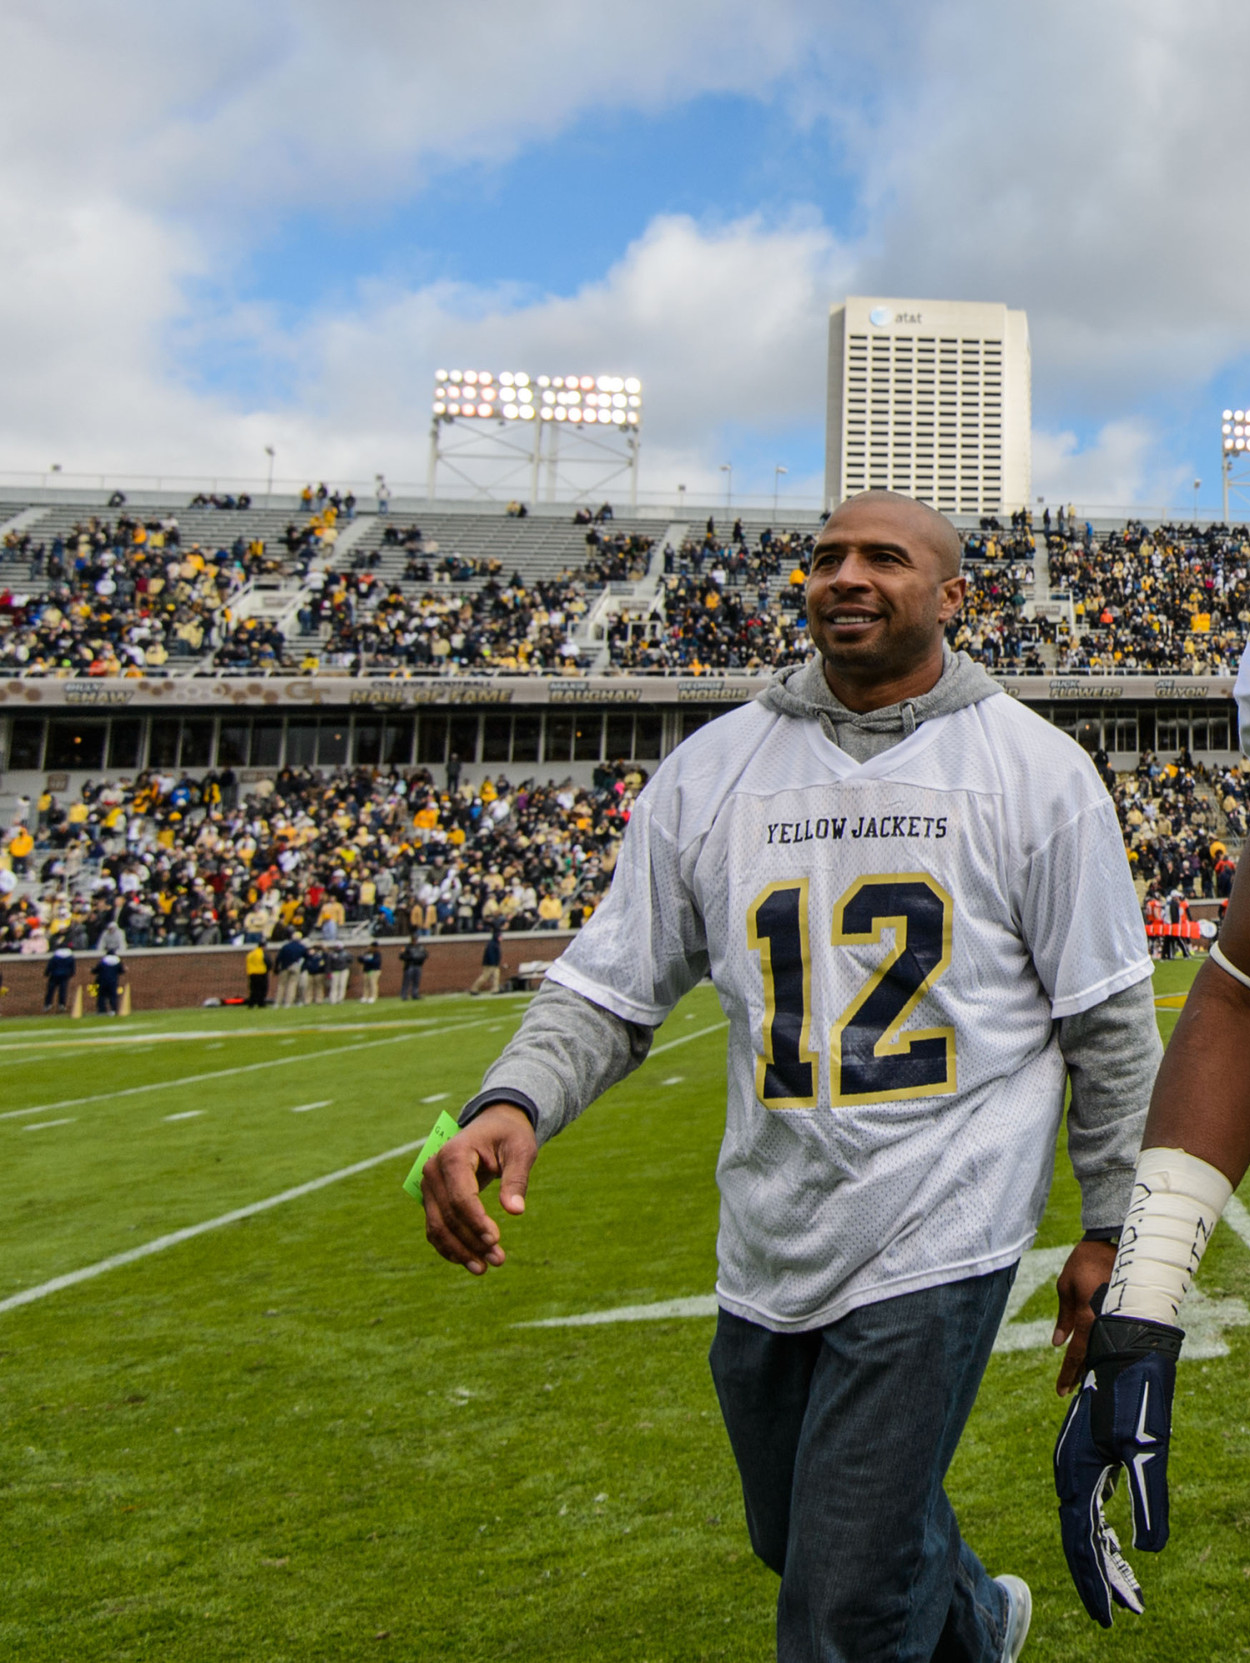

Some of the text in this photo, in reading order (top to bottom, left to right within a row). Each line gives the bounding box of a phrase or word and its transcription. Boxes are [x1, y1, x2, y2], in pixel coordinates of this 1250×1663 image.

[372, 680, 492, 688] COLLEGE FOOTBALL
[1050, 679, 1078, 689] BUCK
[1156, 679, 1175, 688] JOE
[351, 689, 514, 704] HALL OF FAME
[550, 689, 641, 702] BAUGHAN
[678, 689, 749, 701] MORRIS
[1050, 686, 1122, 699] FLOWERS
[1155, 686, 1208, 699] GUYON
[767, 816, 948, 844] YELLOW JACKETS
[746, 872, 957, 1110] 12
